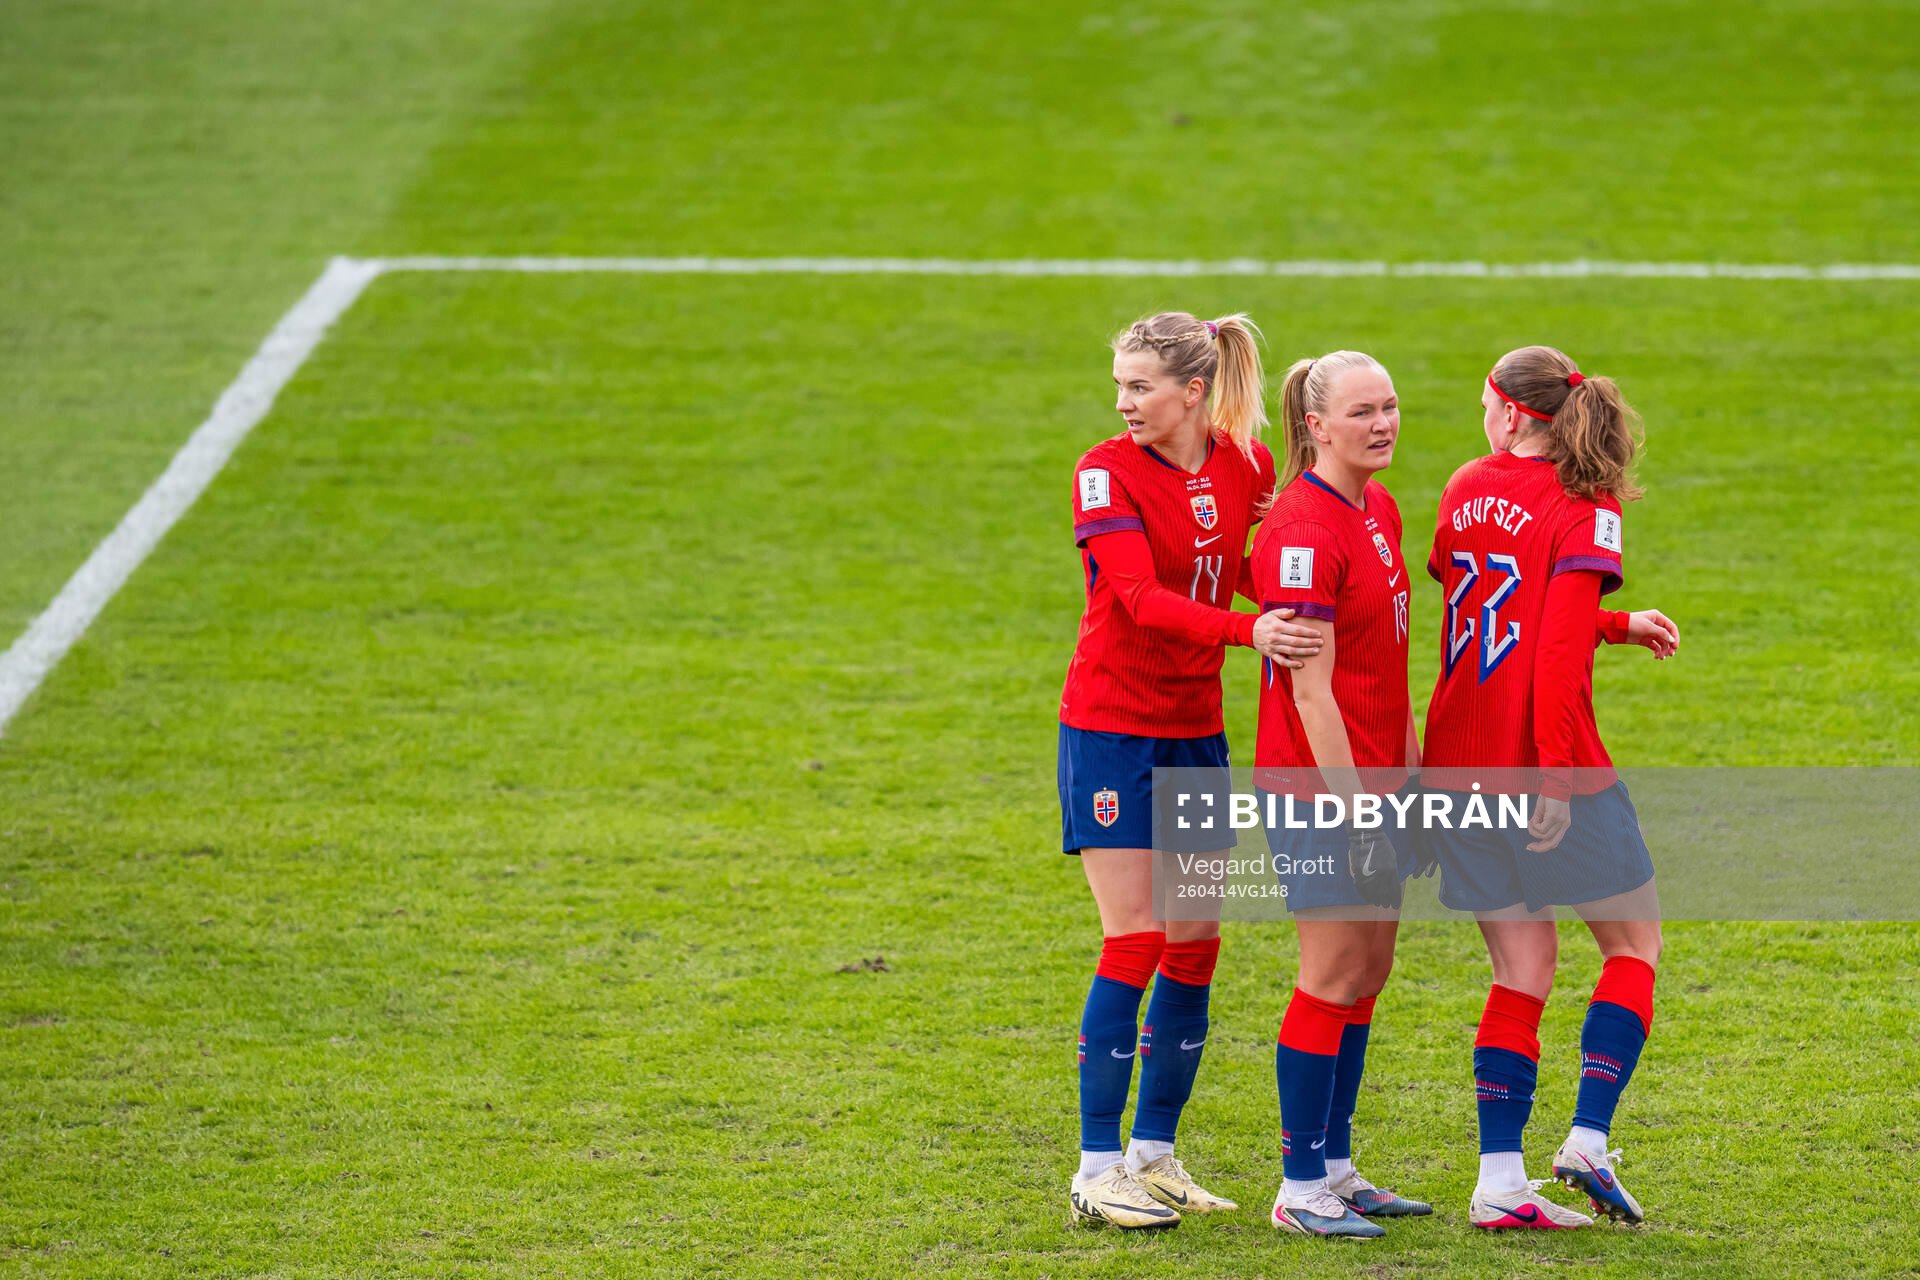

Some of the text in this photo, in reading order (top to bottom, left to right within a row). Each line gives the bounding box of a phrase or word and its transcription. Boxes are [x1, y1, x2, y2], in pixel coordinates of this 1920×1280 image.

[1190, 555, 1223, 604] 14
[1393, 590, 1407, 645] 18
[1445, 551, 1522, 686] 22
